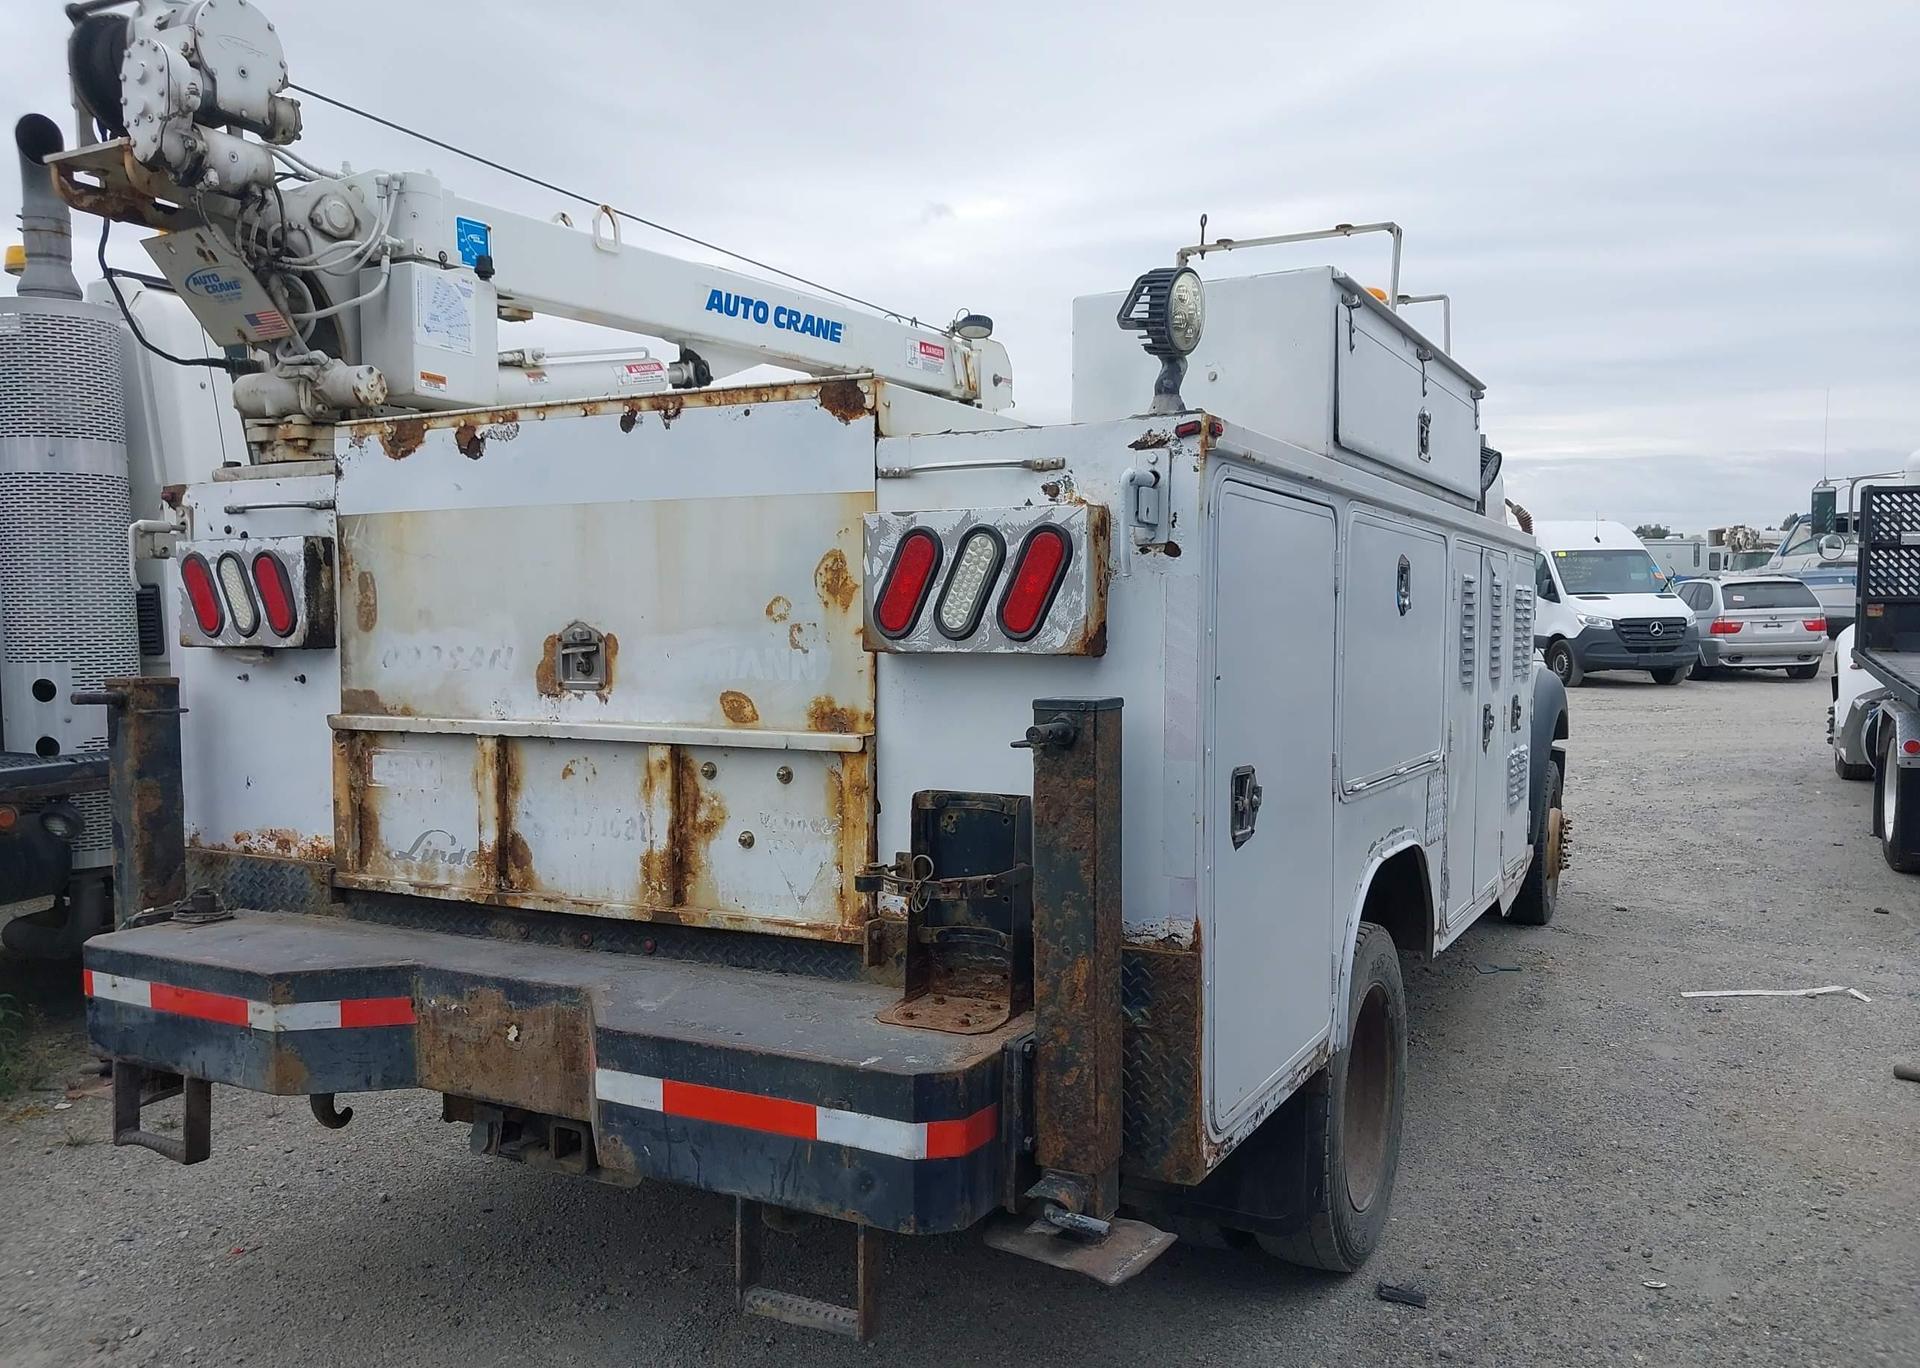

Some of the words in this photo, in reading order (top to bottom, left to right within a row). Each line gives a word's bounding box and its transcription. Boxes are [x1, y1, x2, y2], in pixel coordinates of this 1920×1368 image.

[192, 273, 220, 287] AUTO
[204, 280, 242, 294] CRANE
[705, 289, 769, 325] AUTO
[774, 306, 843, 343] CRANE
[925, 346, 944, 357] DANGER
[636, 363, 661, 372] DANGER
